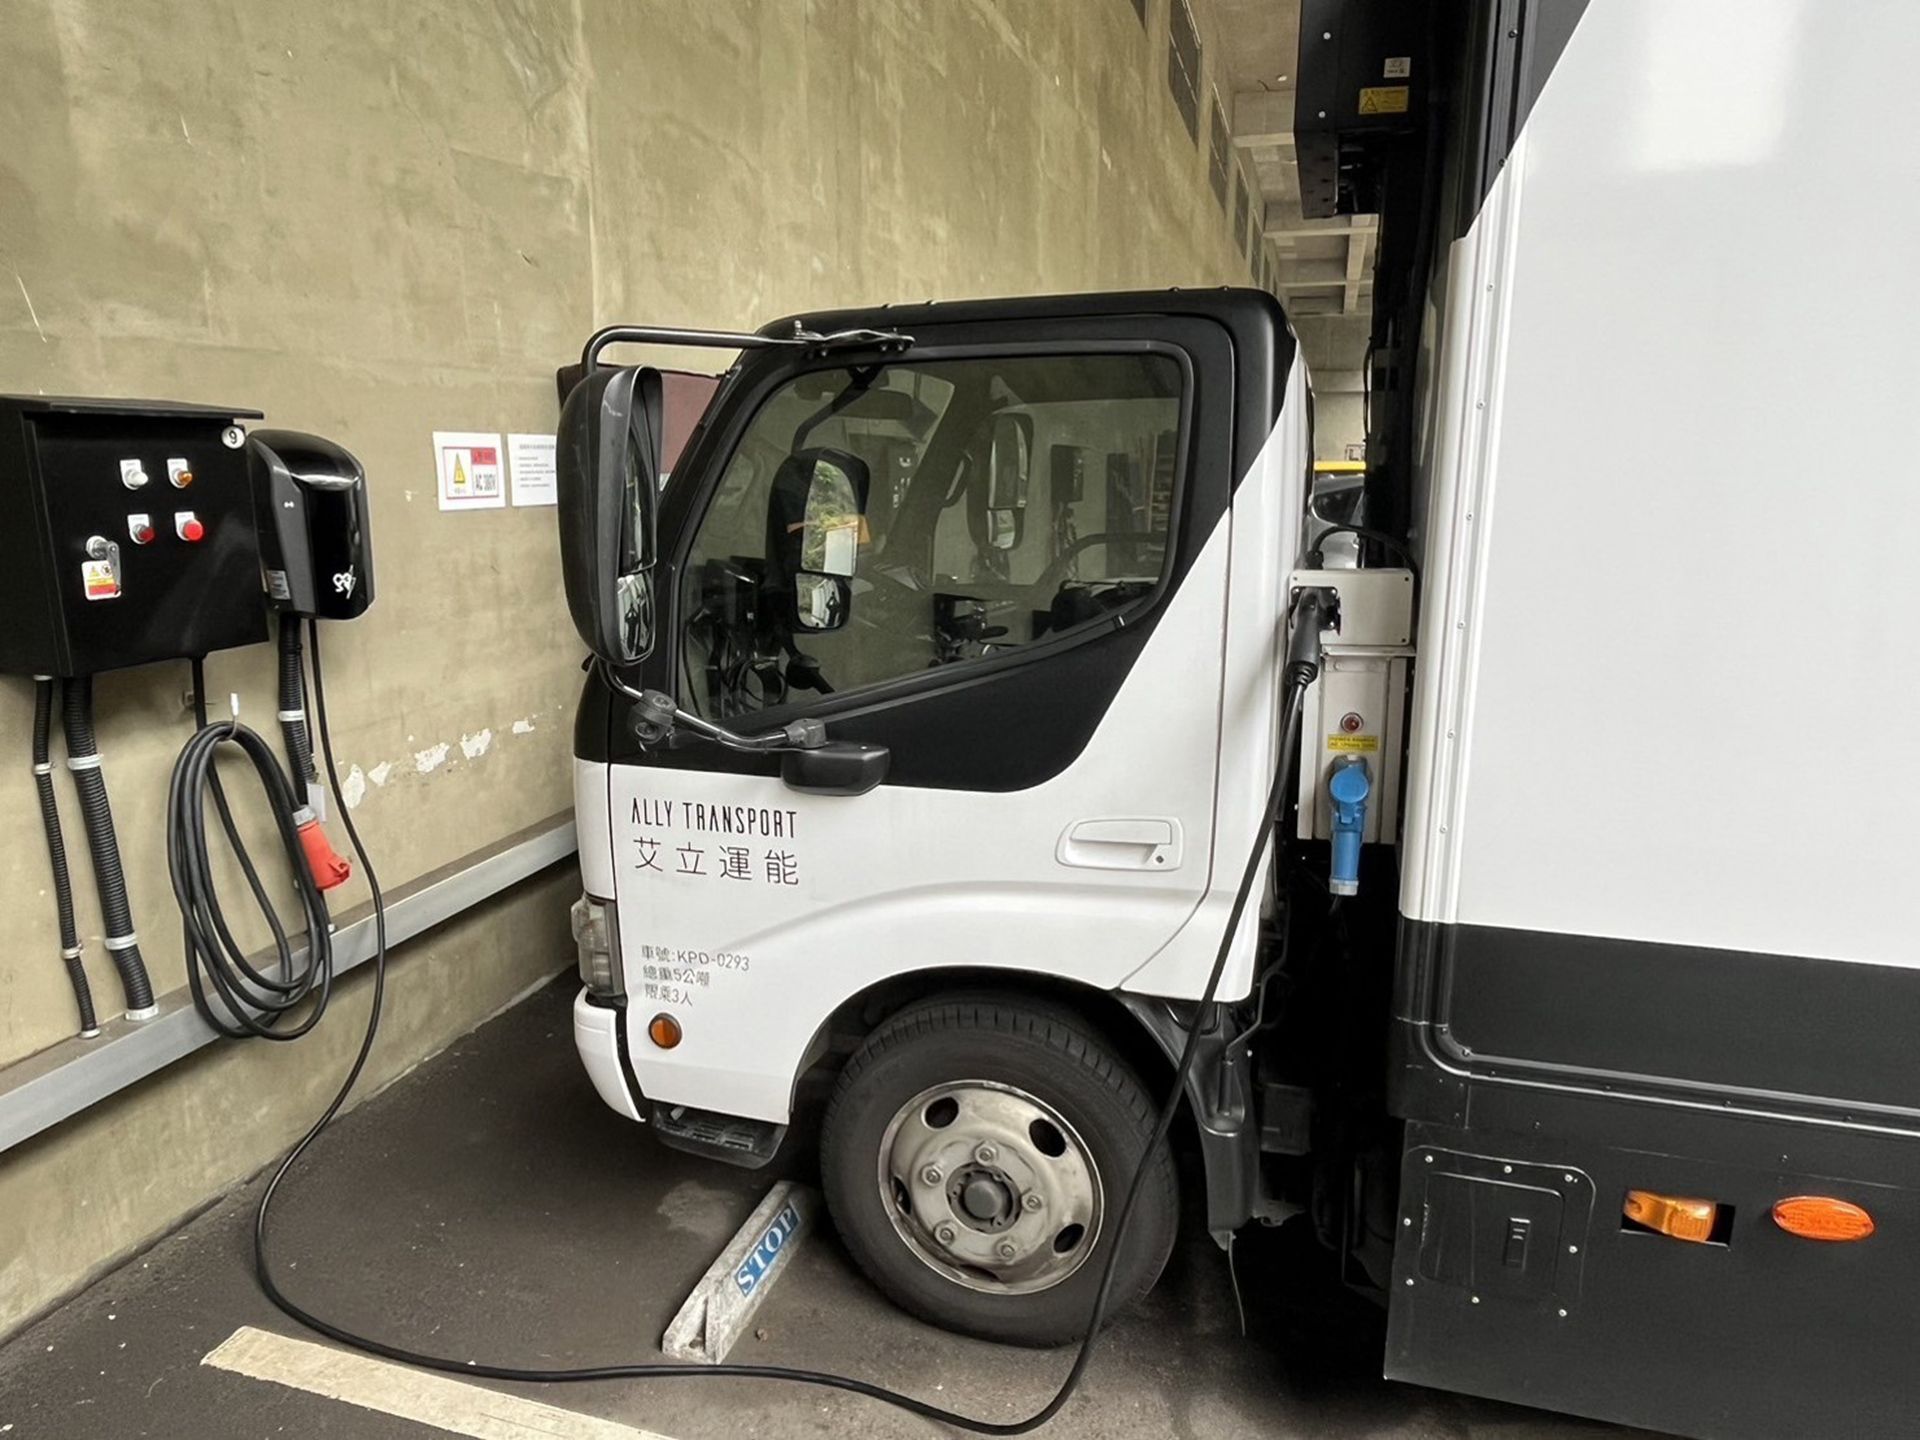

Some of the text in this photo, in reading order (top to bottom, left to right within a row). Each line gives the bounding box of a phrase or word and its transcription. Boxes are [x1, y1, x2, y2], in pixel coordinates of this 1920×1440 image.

[229, 430, 238, 444] 9
[631, 797, 797, 838] ALLY TRANSPORT
[633, 836, 799, 885] 艾立運能
[738, 1207, 794, 1294] STOP
